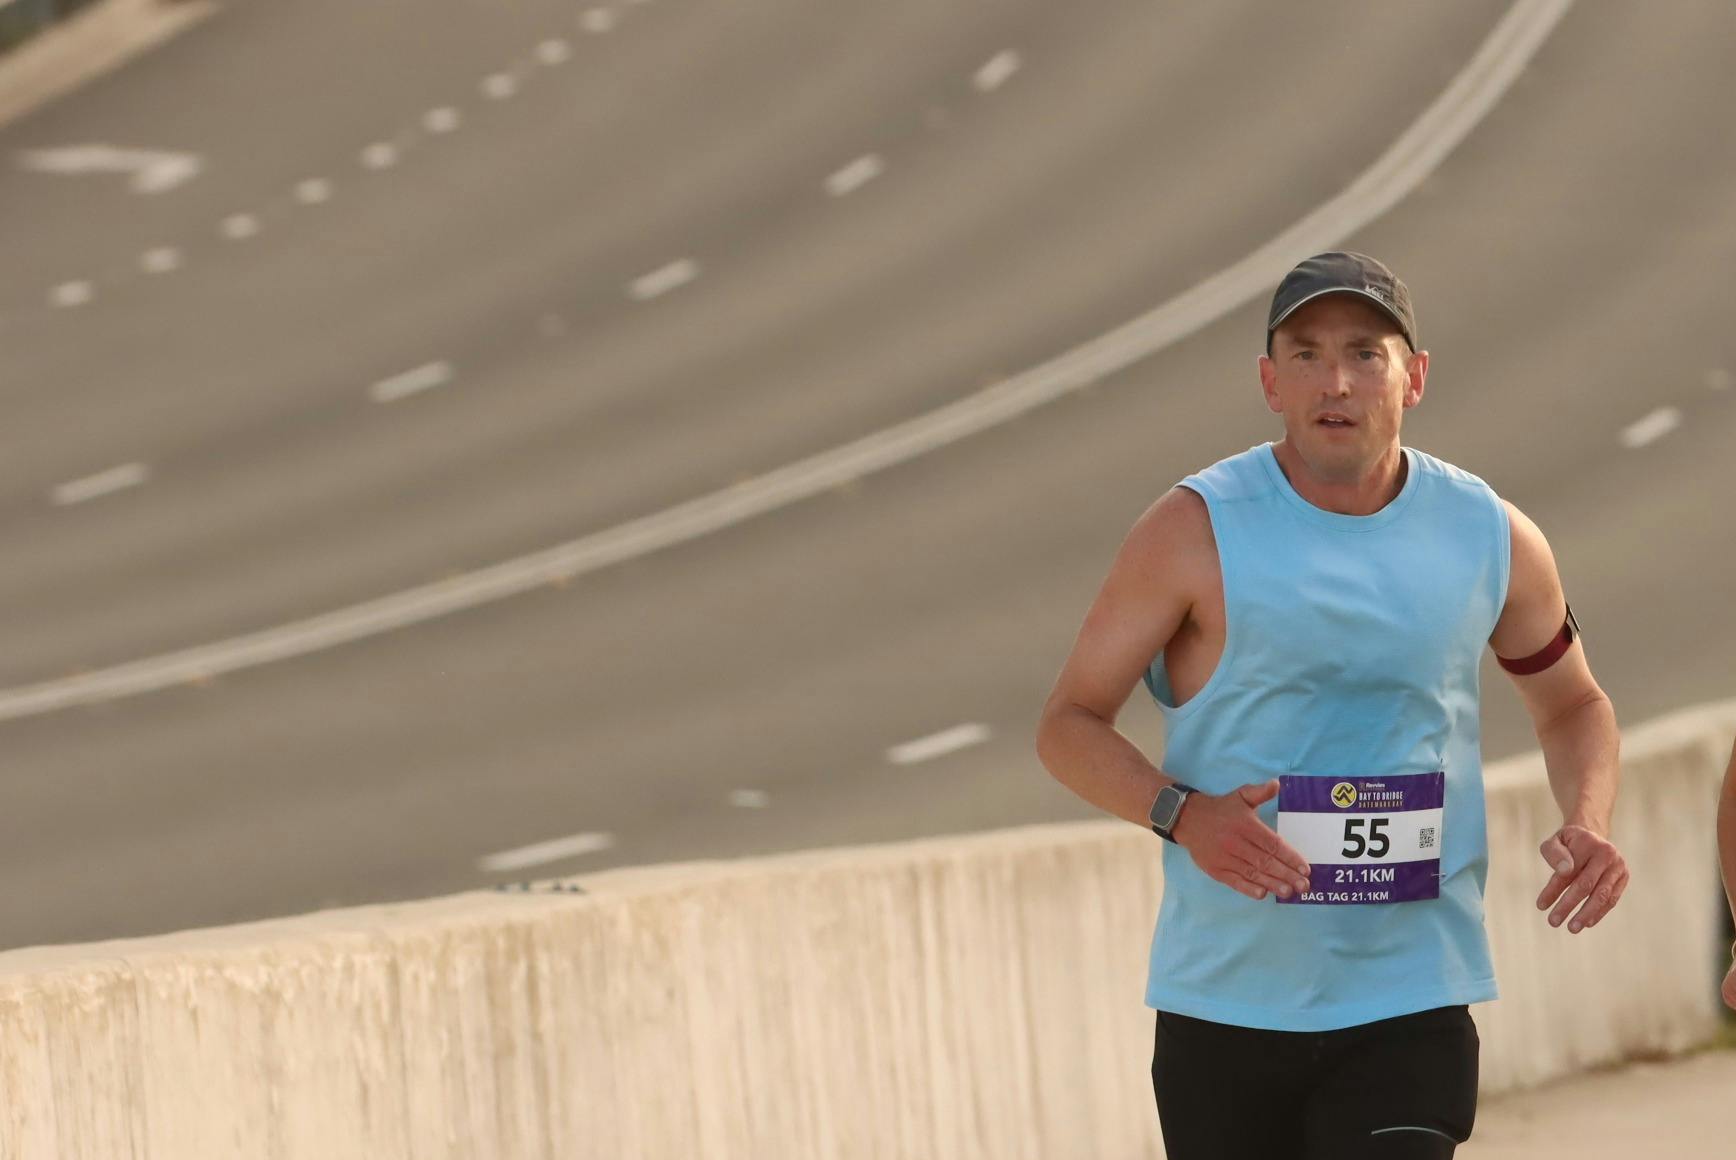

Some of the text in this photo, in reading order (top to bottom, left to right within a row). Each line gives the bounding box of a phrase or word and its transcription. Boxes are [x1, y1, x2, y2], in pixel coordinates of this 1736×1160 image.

[1359, 791, 1403, 800] BAY TO BRIDGE
[1341, 818, 1390, 859] 55
[1335, 868, 1395, 883] 21.1KM
[1301, 891, 1389, 901] BAG TAG 21.1KM
